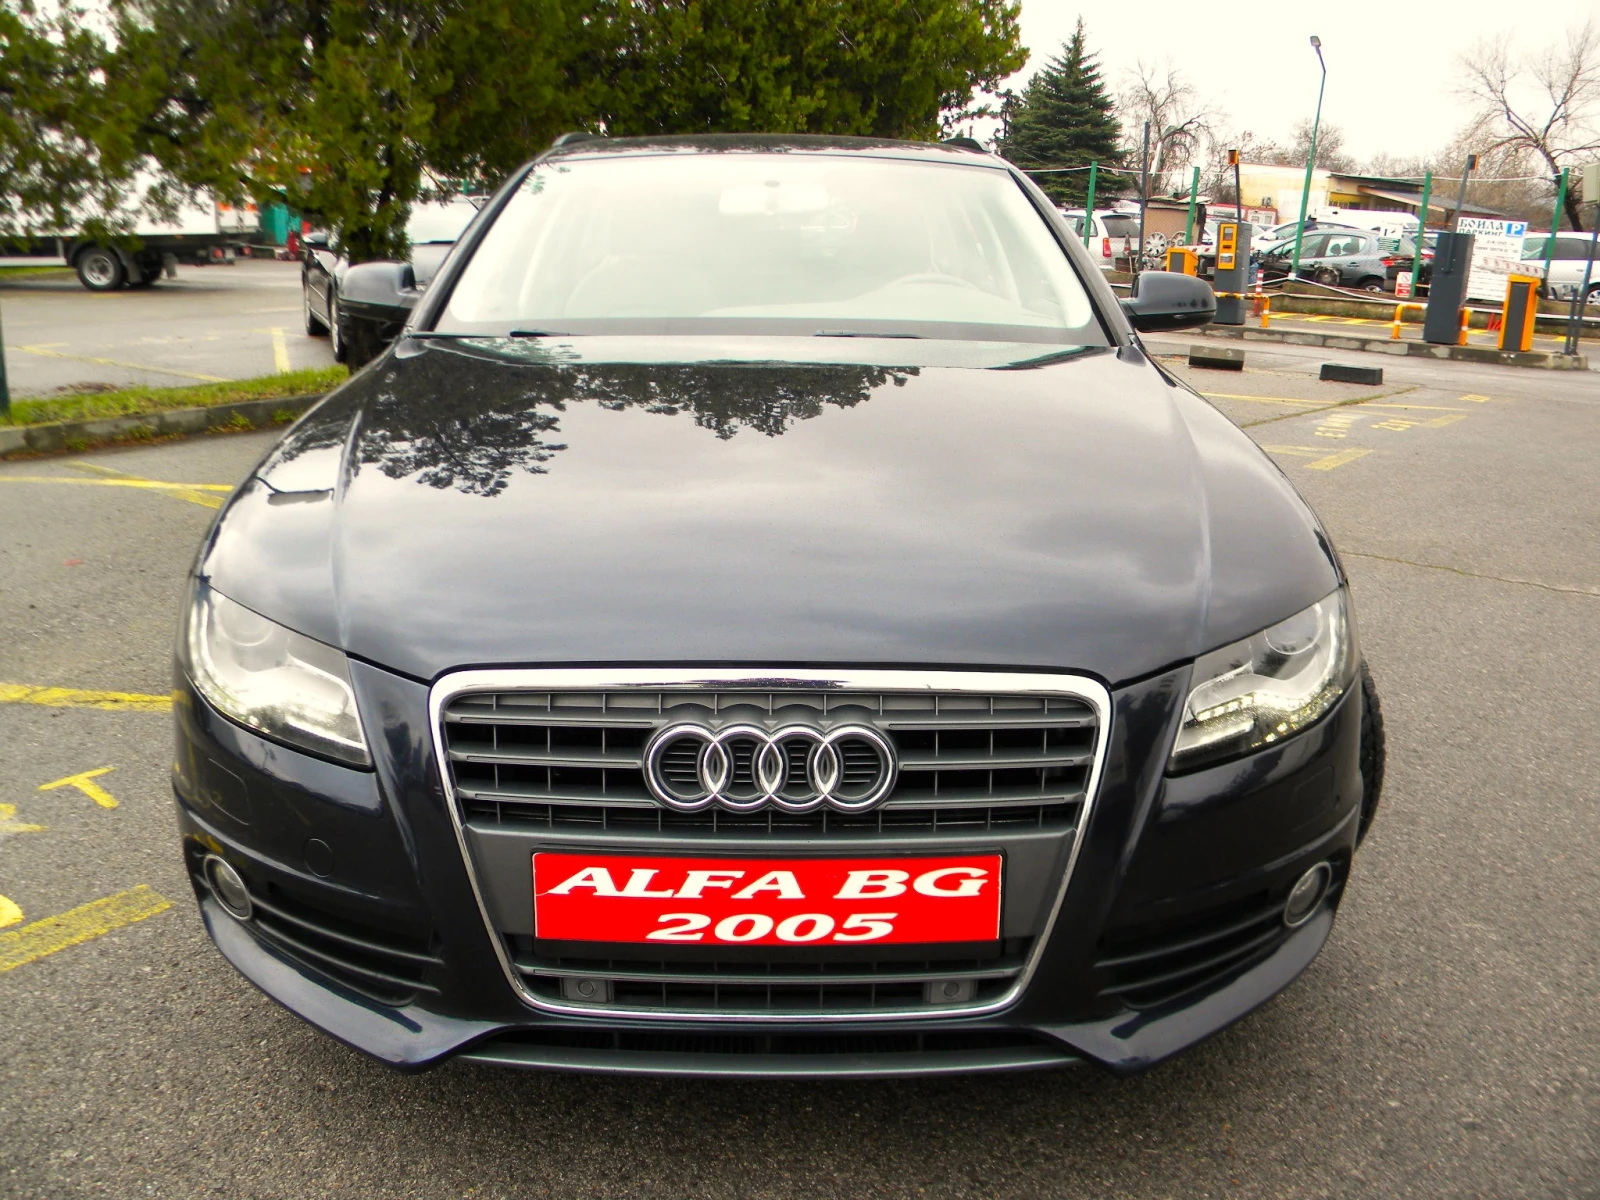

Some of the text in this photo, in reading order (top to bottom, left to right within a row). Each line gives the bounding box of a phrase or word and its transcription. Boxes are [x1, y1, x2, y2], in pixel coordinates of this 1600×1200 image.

[1459, 228, 1503, 236] ПАРКИНГ
[547, 867, 988, 898] ALFA BG
[646, 912, 898, 943] 2005
